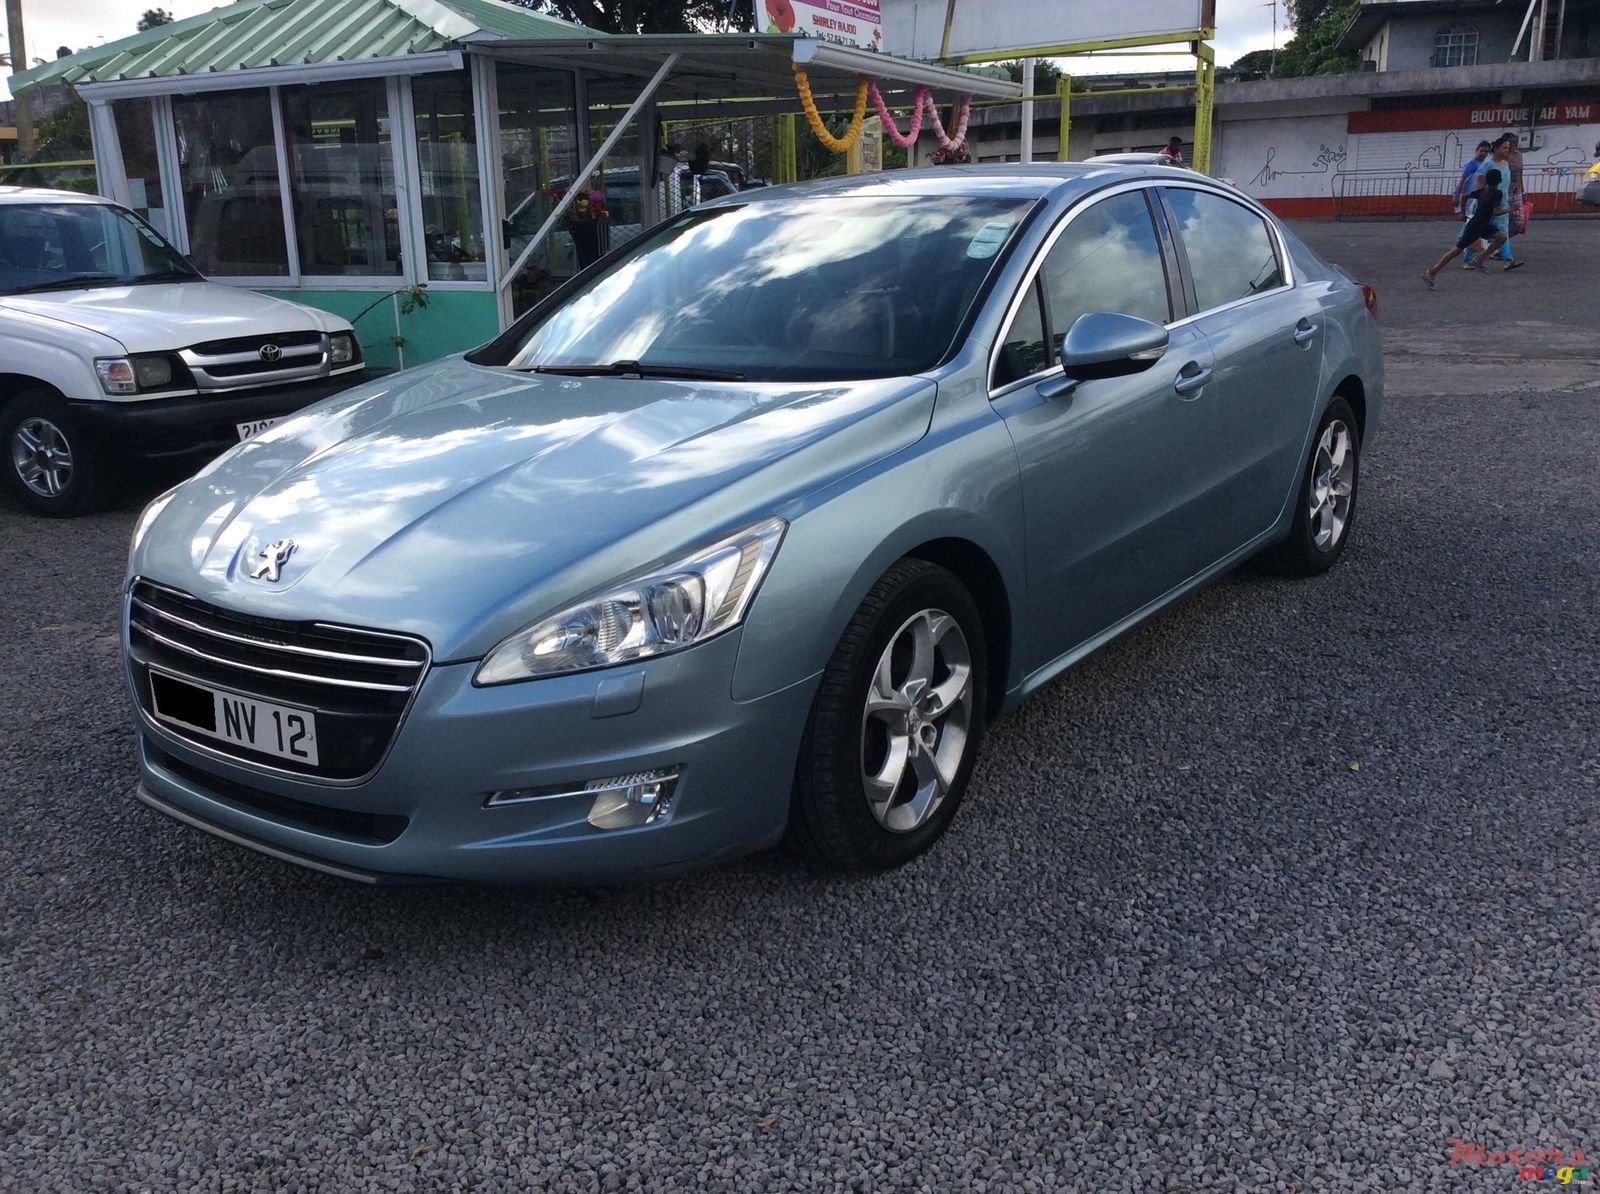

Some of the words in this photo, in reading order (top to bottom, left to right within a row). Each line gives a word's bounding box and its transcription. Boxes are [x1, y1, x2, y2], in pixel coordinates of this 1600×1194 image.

[826, 1, 840, 12] Pour
[840, 4, 854, 16] Tout
[854, 8, 880, 23] Occasion
[812, 14, 837, 30] SHIRLEY
[837, 20, 857, 35] RAJOO
[1471, 107, 1530, 124] BOUTIQUE
[1539, 106, 1557, 120] AH
[1565, 105, 1590, 119] YAM
[222, 697, 256, 744] NV
[272, 710, 308, 758] 12
